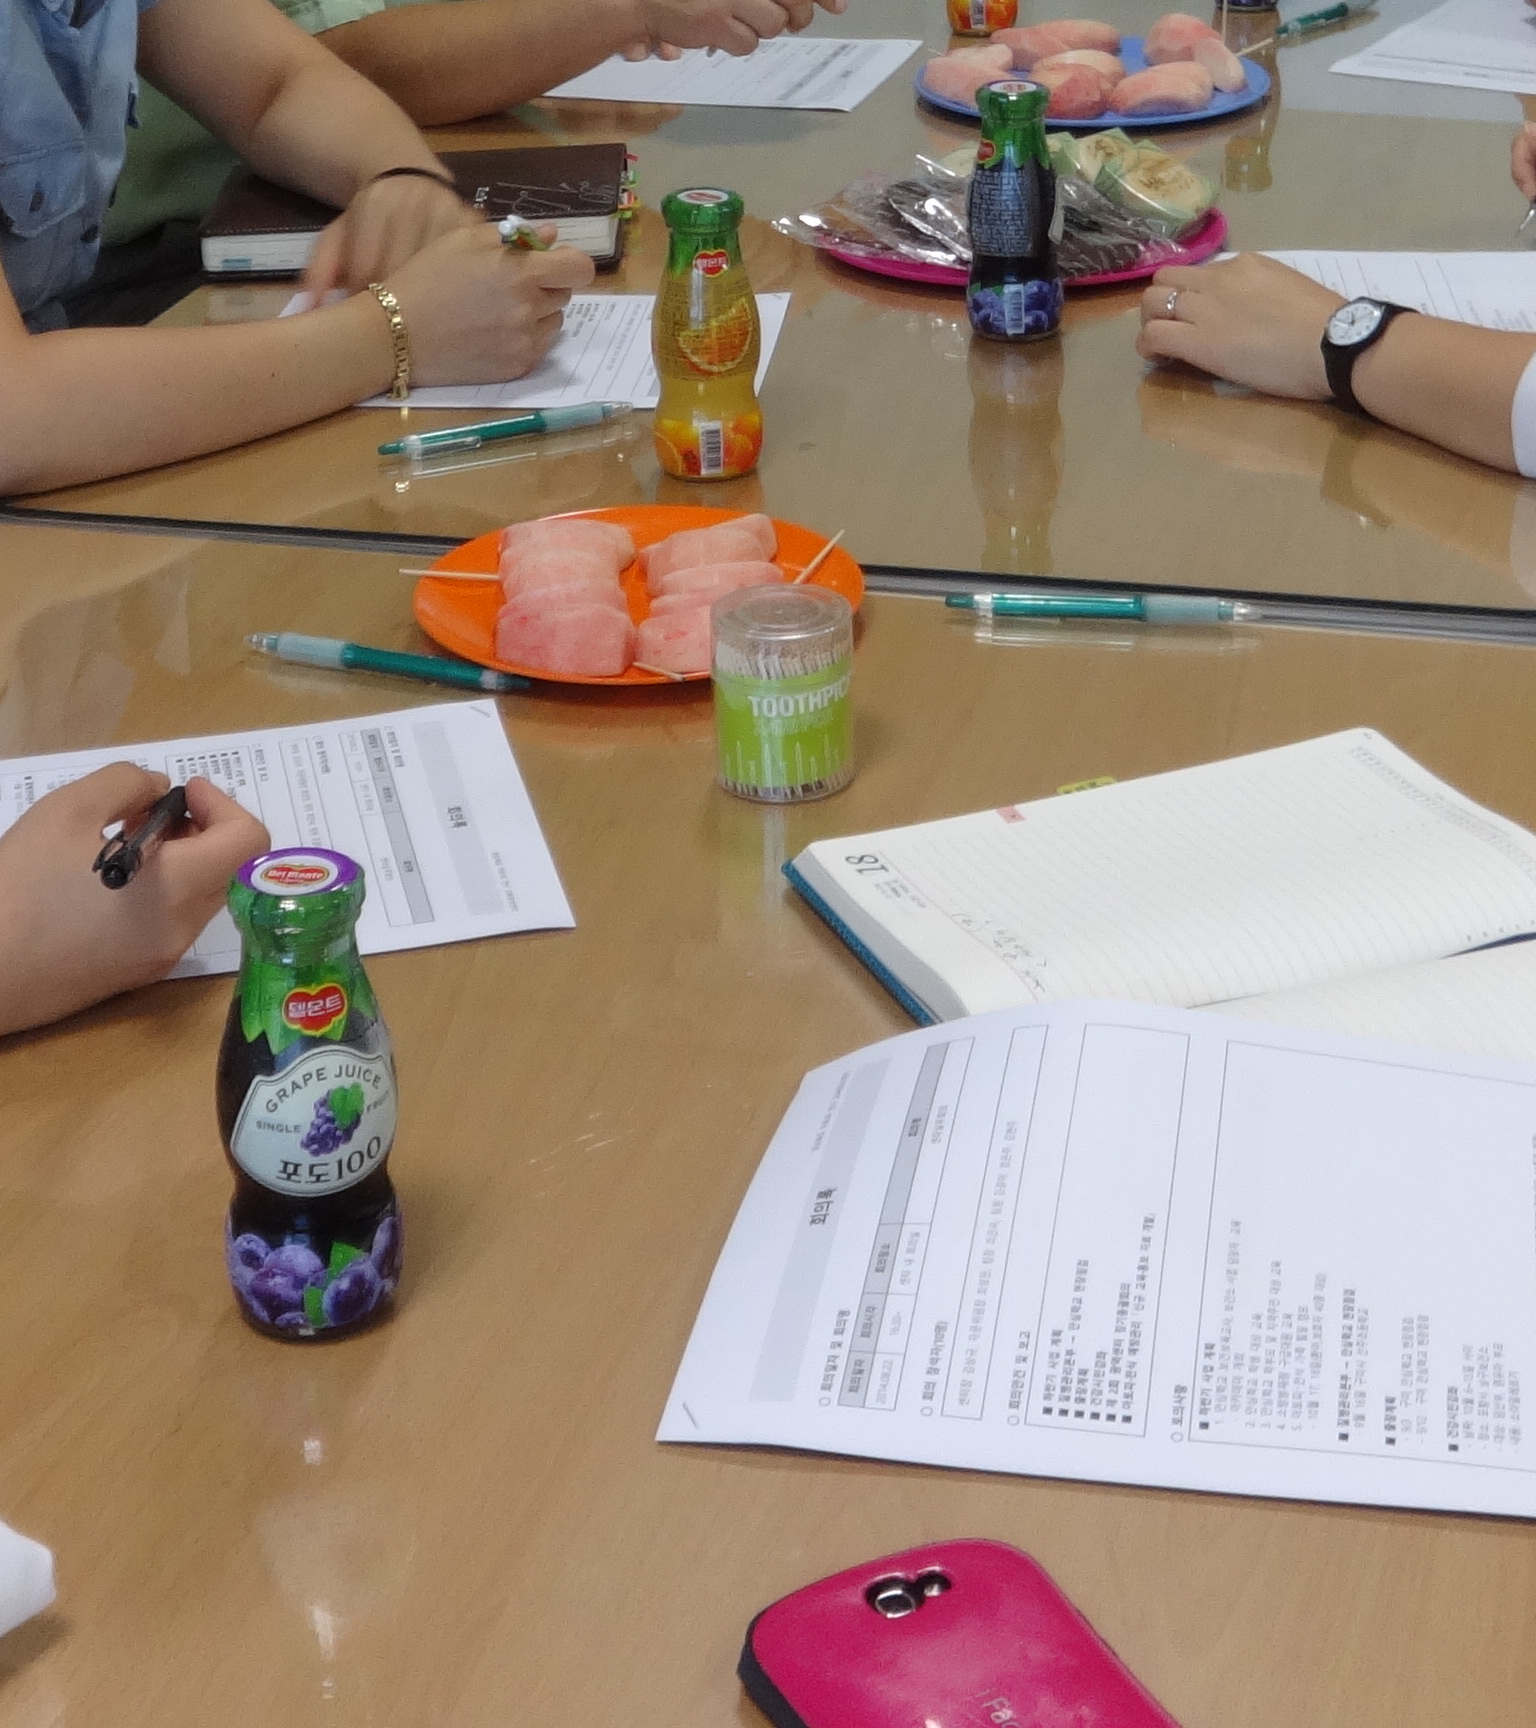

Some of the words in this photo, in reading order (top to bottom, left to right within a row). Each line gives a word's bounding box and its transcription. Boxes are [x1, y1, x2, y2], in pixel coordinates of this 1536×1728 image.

[267, 869, 285, 879] Del
[286, 869, 324, 880] Monte
[288, 994, 342, 1018] 델몬트
[265, 1067, 327, 1113] GRAPE
[334, 1064, 382, 1090] JUICE
[256, 1120, 301, 1134] SINGLE
[275, 1136, 382, 1184] 포도100
[808, 1187, 837, 1226] 회의록
[830, 1341, 843, 1350] 및
[1171, 1384, 1188, 1427] 토의사항
